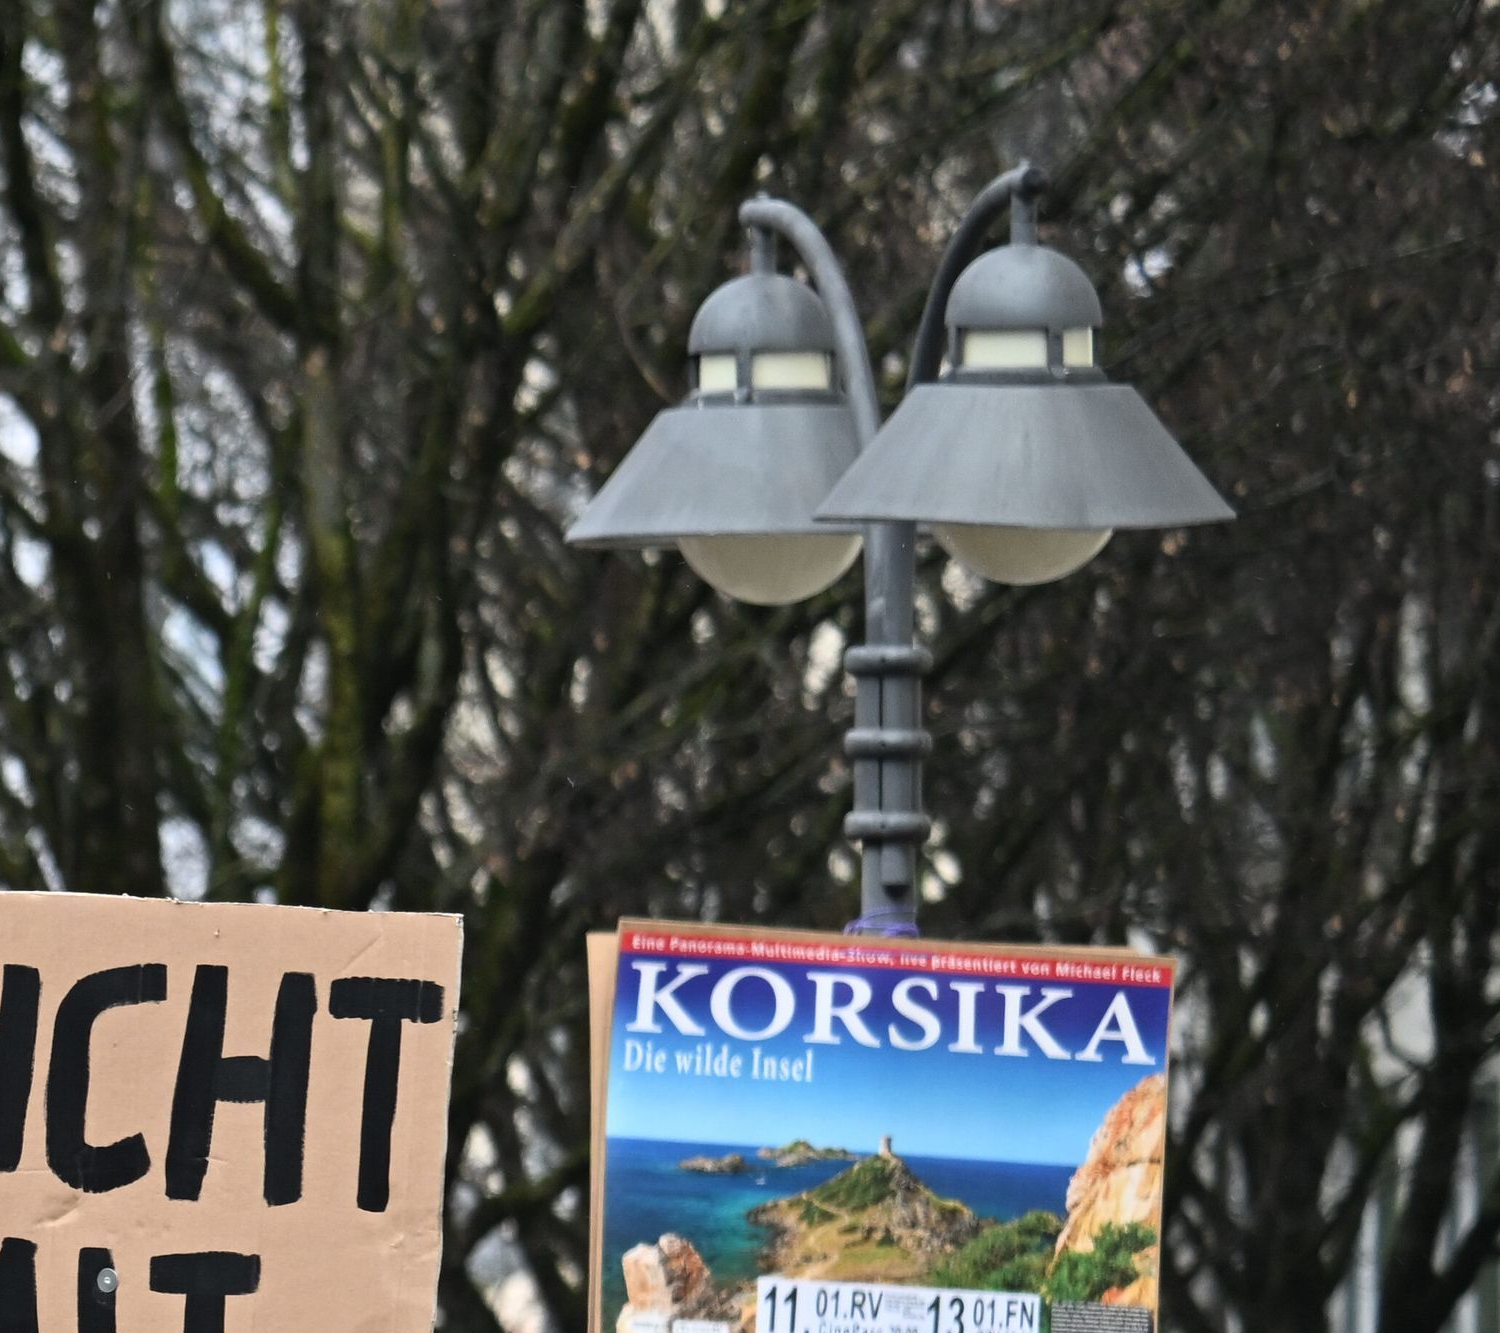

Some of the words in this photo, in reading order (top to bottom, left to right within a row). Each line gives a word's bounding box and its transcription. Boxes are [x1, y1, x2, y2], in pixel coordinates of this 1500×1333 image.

[632, 934, 665, 951] Eine
[931, 955, 1016, 975] präsentiert
[1021, 962, 1049, 976] von
[1055, 962, 1117, 981] Michael
[1122, 966, 1161, 984] Fleck
[625, 959, 1156, 1066] KORSIKA
[623, 1039, 666, 1073] Die
[675, 1044, 743, 1079] wilde
[751, 1047, 814, 1083] Insel
